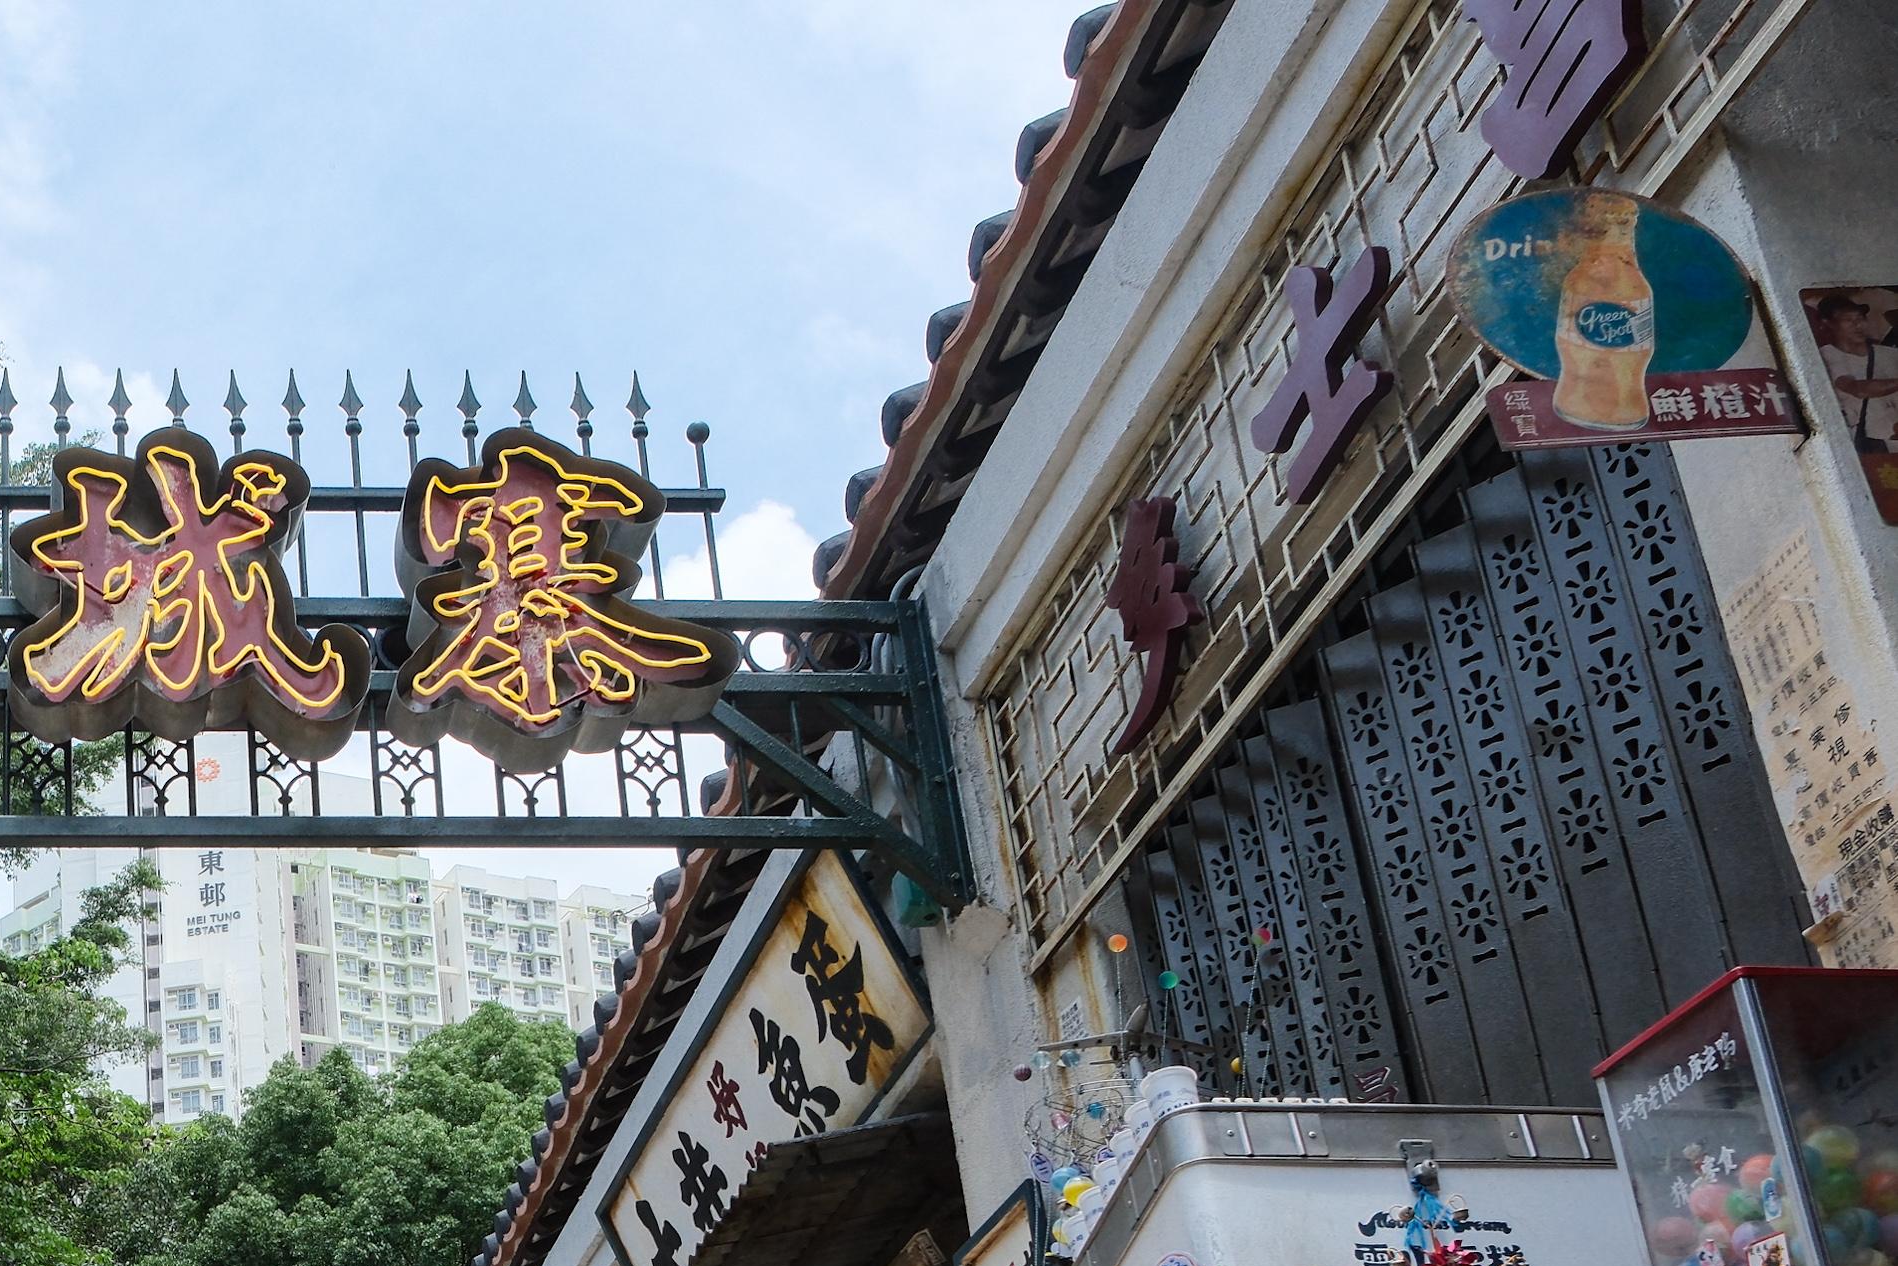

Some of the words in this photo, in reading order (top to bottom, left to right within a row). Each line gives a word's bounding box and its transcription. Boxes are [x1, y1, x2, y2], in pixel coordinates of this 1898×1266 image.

[1580, 306, 1632, 329] Green
[1596, 321, 1632, 344] Spot
[1651, 382, 1789, 422] 鮮橙汁
[186, 914, 207, 927] MEI
[209, 910, 242, 924] TUNG
[187, 924, 230, 937] ESTATE
